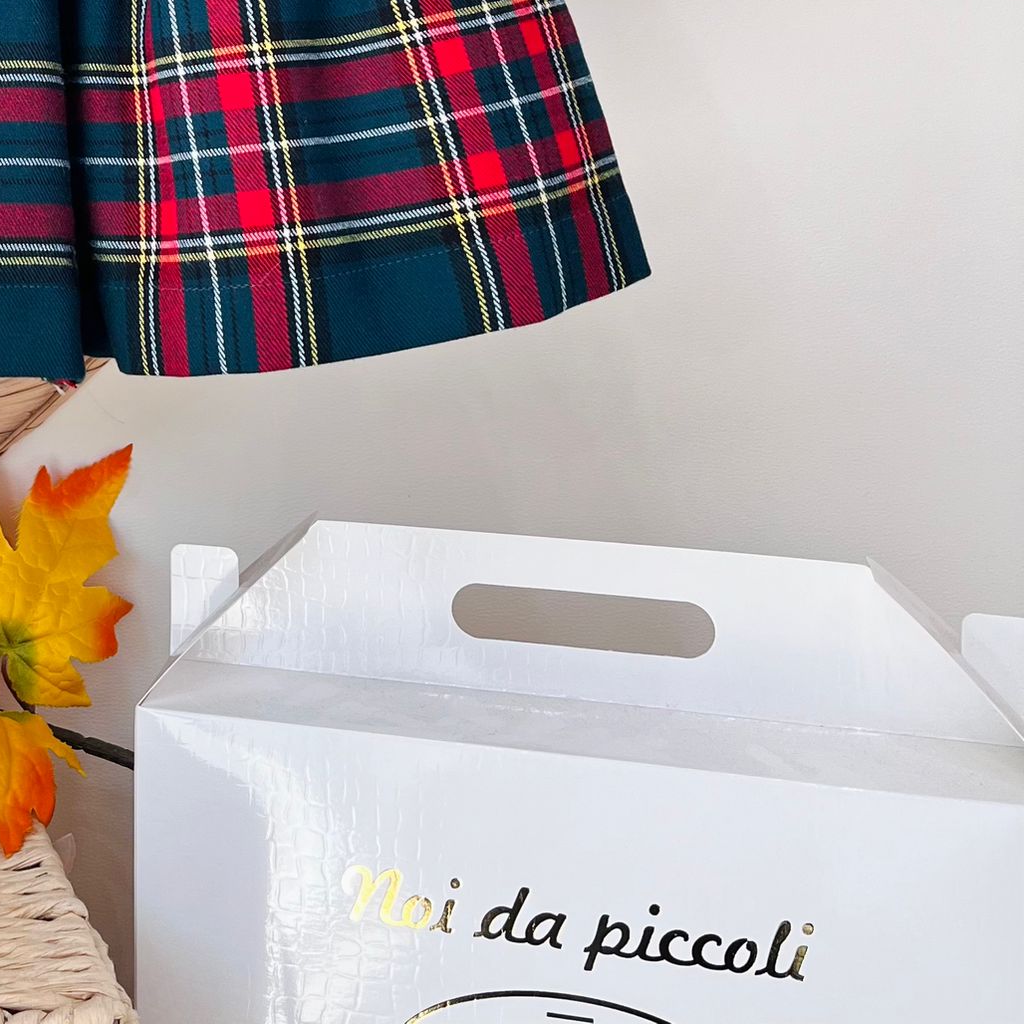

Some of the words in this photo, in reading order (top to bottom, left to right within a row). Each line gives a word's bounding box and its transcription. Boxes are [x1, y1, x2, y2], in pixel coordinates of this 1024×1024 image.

[341, 864, 461, 934] Noi
[473, 886, 567, 949] da
[583, 903, 815, 982] piccoli
